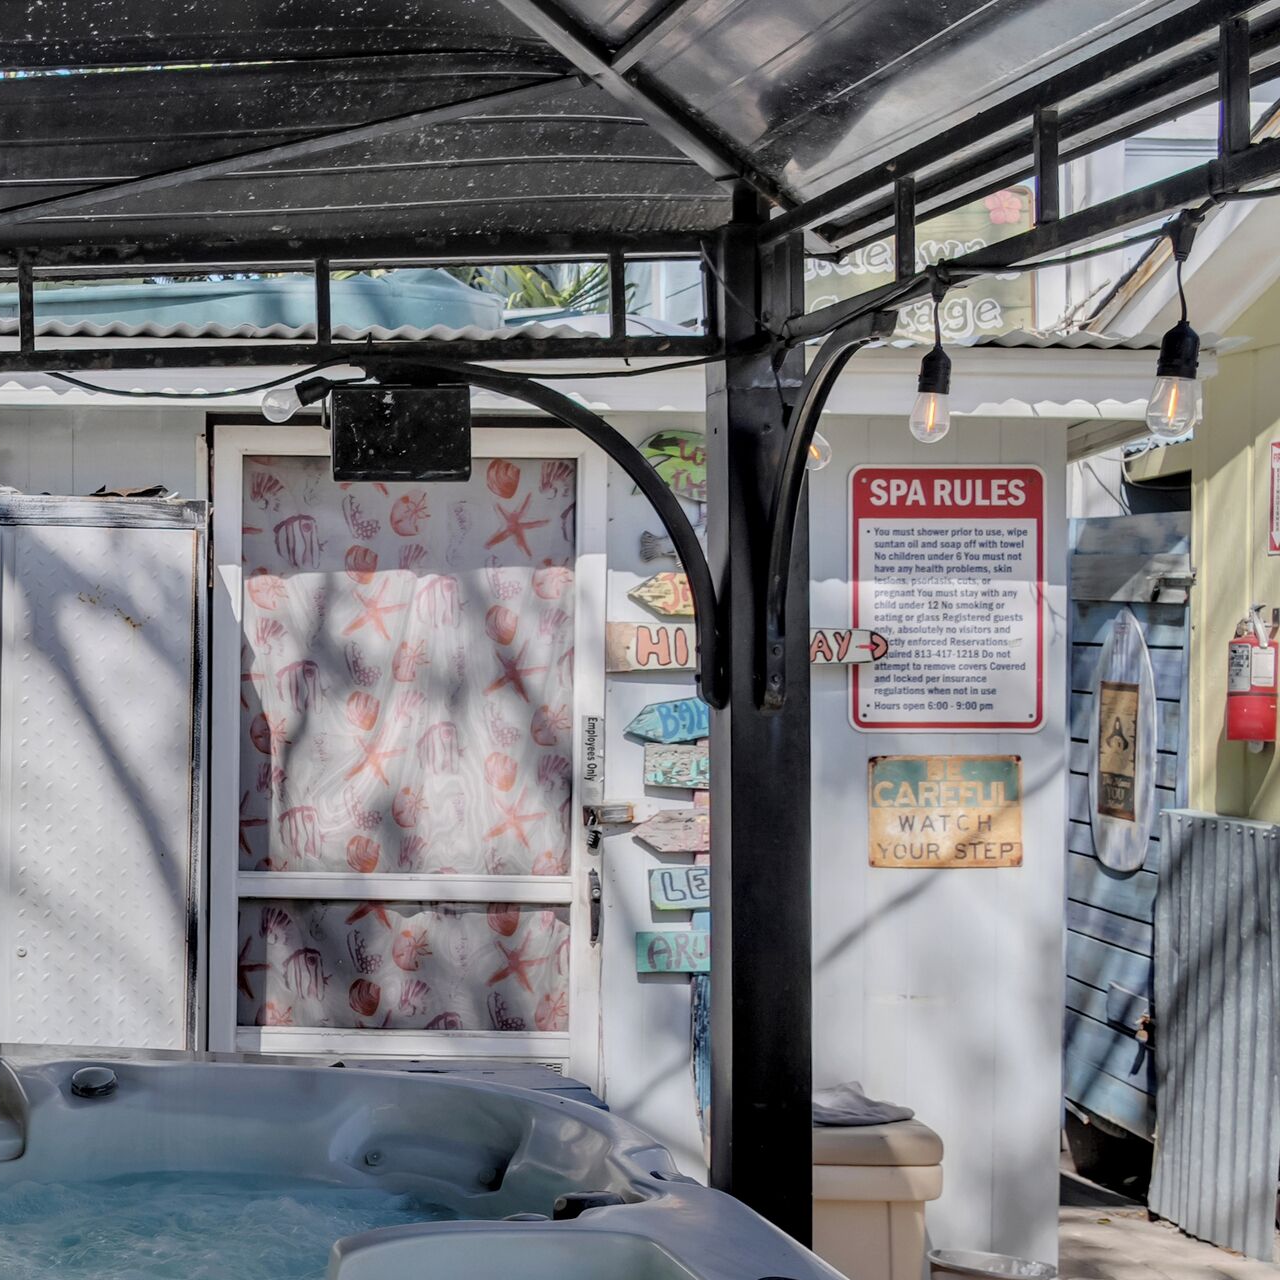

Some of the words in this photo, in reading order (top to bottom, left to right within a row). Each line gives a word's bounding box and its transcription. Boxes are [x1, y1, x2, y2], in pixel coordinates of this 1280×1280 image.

[870, 479, 927, 506] SPA
[934, 479, 1026, 506] RULES
[874, 527, 890, 536] You
[892, 527, 915, 536] must
[917, 527, 949, 536] shower
[951, 527, 973, 538] prior
[974, 527, 984, 536] to
[1007, 527, 1028, 538] wipe
[874, 540, 906, 548] suntan
[907, 540, 919, 548] oil
[921, 540, 938, 548] and
[940, 541, 962, 550] soap
[964, 540, 976, 548] off
[978, 540, 998, 548] with
[1000, 540, 1024, 548] towel
[874, 552, 886, 560] No
[888, 552, 926, 560] children
[928, 552, 954, 560] under
[964, 552, 980, 560] You
[982, 552, 1005, 560] must
[1007, 552, 1022, 560] not
[874, 564, 895, 573] have
[898, 565, 914, 575] any
[915, 564, 944, 573] health
[993, 564, 1012, 573] skin
[874, 589, 916, 599] pregnant
[917, 589, 933, 597] You
[935, 589, 958, 597] must
[960, 589, 979, 599] stay
[980, 589, 1000, 597] with
[1002, 590, 1018, 599] any
[874, 601, 896, 609] child
[898, 601, 925, 609] under
[928, 601, 939, 609] 12
[941, 601, 954, 609] No
[956, 601, 994, 611] smoking
[874, 613, 903, 624] eating
[905, 614, 915, 622] or
[916, 613, 941, 624] glass
[942, 613, 992, 624] Registered
[993, 613, 1024, 624] guests
[897, 625, 944, 636] absolutely
[946, 626, 957, 634] no
[959, 625, 992, 634] visitors
[994, 625, 1011, 634] and
[907, 637, 948, 646] enforced
[950, 637, 1008, 646] Reservations
[982, 650, 994, 658] Do
[996, 650, 1011, 658] not
[874, 662, 910, 672] attempt
[912, 662, 922, 670] to
[990, 662, 1026, 670] Covered
[874, 674, 891, 683] and
[893, 674, 924, 683] locked
[926, 675, 941, 685] per
[942, 674, 987, 683] insurance
[874, 686, 926, 697] regulations
[927, 686, 952, 695] when
[953, 686, 968, 695] not
[970, 686, 979, 695] in
[980, 687, 997, 695] use
[874, 701, 901, 710] Hours
[903, 702, 925, 712] open
[928, 701, 948, 710] 6:00
[956, 701, 978, 710] 9:00
[979, 702, 994, 712] pm
[585, 717, 598, 760] Employees
[583, 763, 597, 781] Only
[927, 761, 964, 780] BE
[873, 780, 1010, 807] CAREFUL
[899, 814, 992, 832] WATCH
[877, 842, 940, 860] YOUR
[955, 841, 1014, 860] STEP
